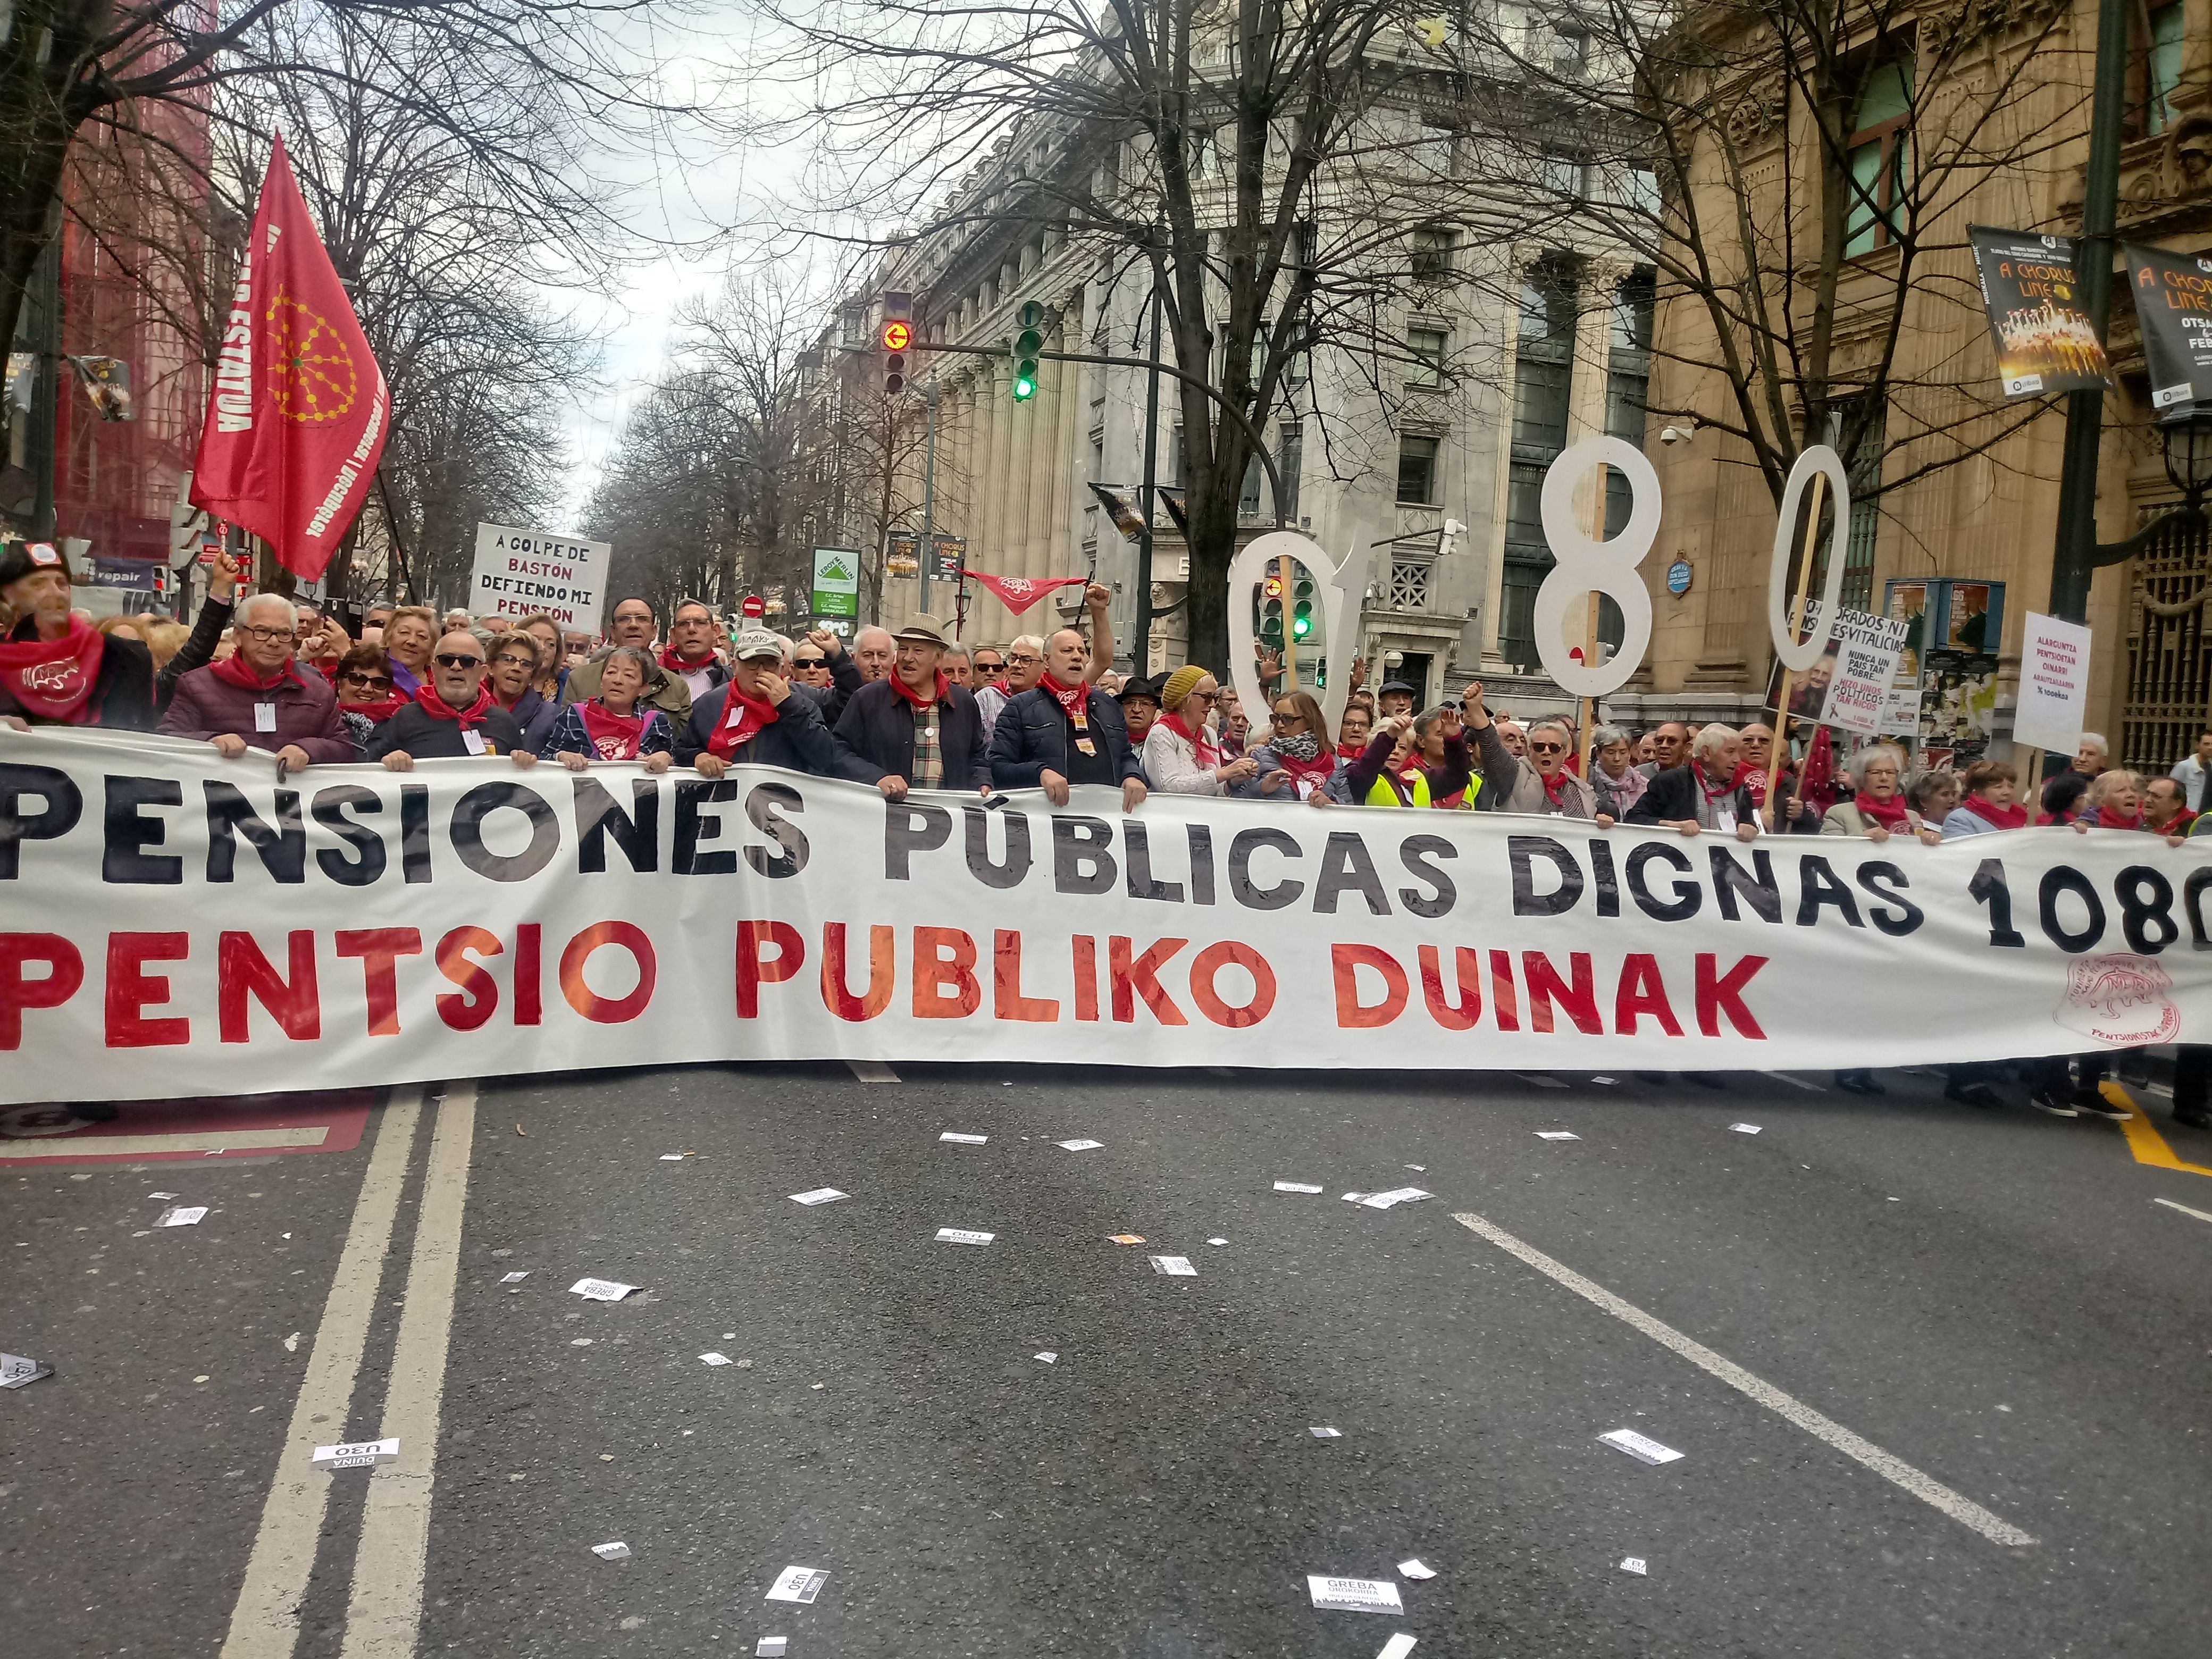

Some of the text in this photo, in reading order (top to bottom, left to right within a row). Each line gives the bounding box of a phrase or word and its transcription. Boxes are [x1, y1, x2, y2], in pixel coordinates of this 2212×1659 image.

[1999, 262, 2076, 284] A CHORUS
[2138, 267, 2155, 288] A
[2019, 281, 2052, 298] LINE
[2165, 290, 2210, 312] LINE
[496, 534, 590, 562] A GOLPE DE
[941, 542, 965, 551] CHORUS
[1534, 437, 1662, 697] 8
[1769, 445, 1851, 672] 0
[98, 571, 141, 583] repair
[508, 558, 572, 581] BASTÓN
[817, 556, 855, 580] LEROY MERLIN
[481, 574, 592, 605] DEFIENDO MI
[1887, 623, 1905, 636] NI
[2038, 636, 2077, 653] ALARGUNTZA
[1848, 650, 1890, 668] NUNCA UN
[2037, 648, 2076, 665] PENTSIOETAN
[1848, 659, 1885, 675] PAIS TAN
[2043, 663, 2068, 675] OINARRI
[1833, 684, 1884, 705] POLITICOS
[1839, 678, 1882, 696] HIZO UNOS
[1836, 694, 1878, 711] TAN RICOS
[0, 762, 810, 886] PENSIONES
[885, 794, 1459, 918] PÚBLICAS
[1507, 835, 1924, 937] DIGNAS
[0, 919, 1769, 1051] PENTSIO PUBLIKO DUINAK
[584, 1285, 614, 1296] GREBA
[333, 1456, 375, 1466] DUINA
[1328, 1580, 1377, 1590] GREBA
[1329, 1587, 1379, 1595] OROKORRA
